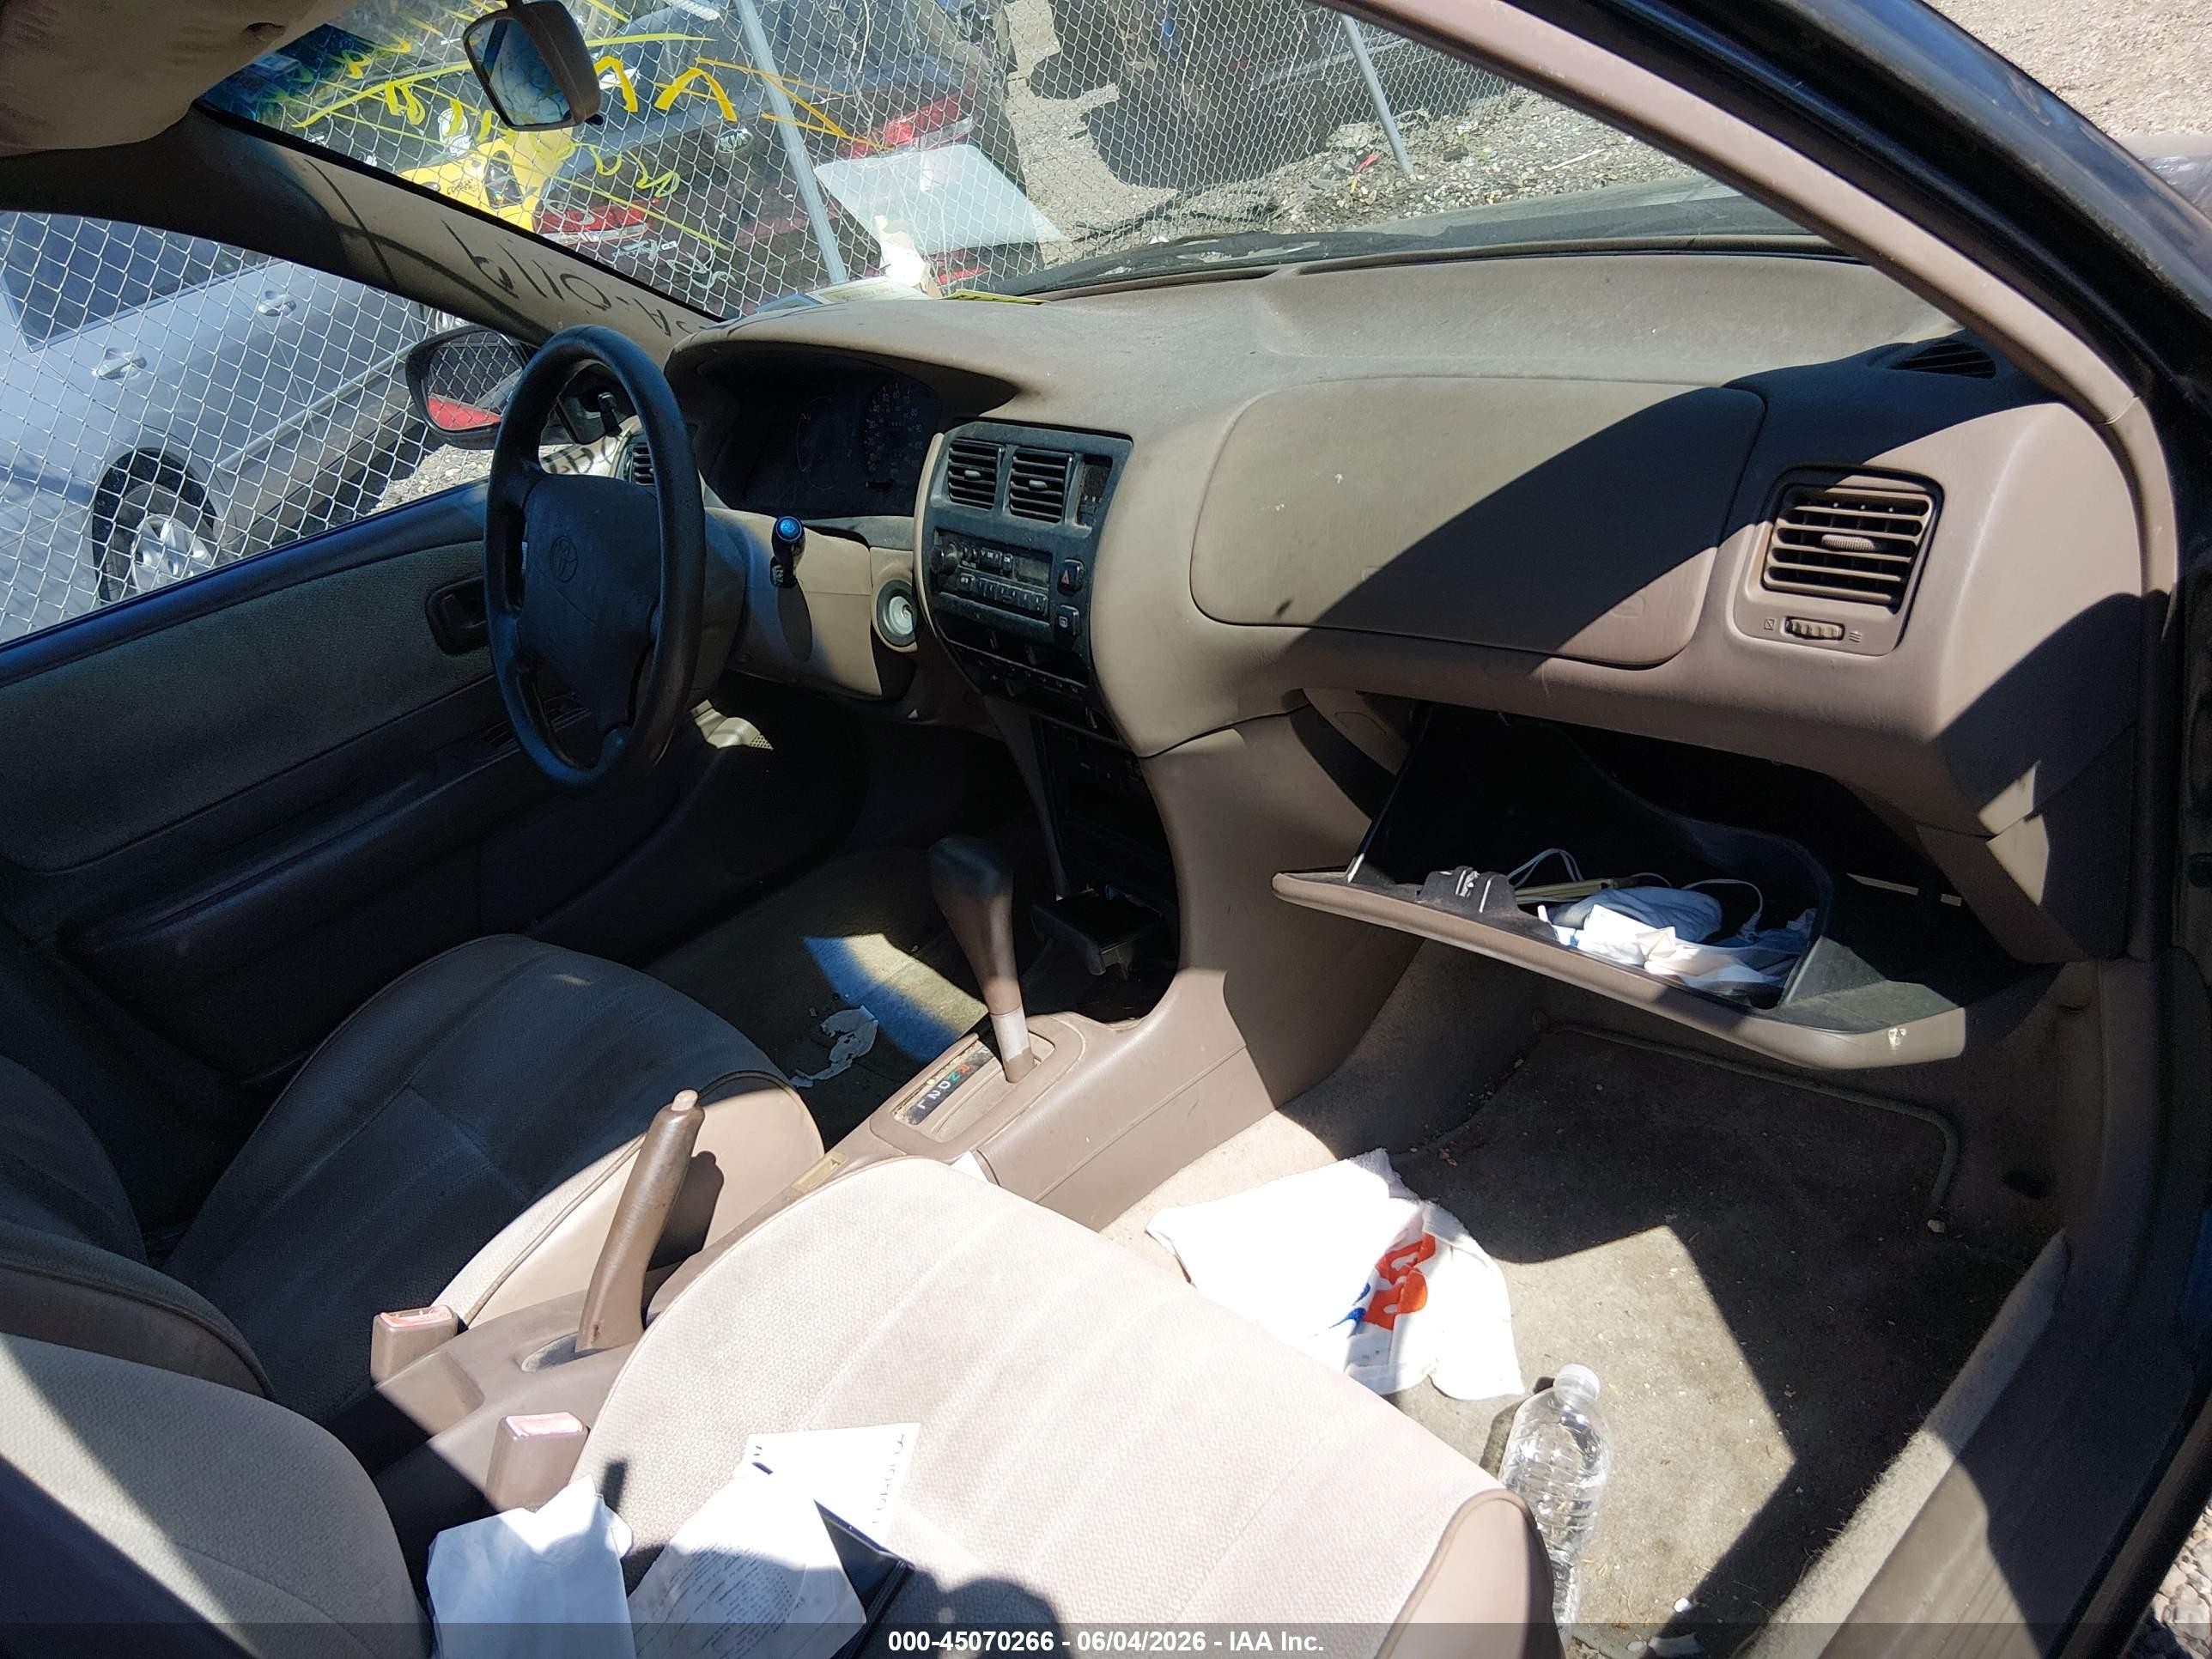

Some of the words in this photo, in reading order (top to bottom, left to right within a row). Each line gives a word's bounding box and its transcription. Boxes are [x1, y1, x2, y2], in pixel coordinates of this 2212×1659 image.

[938, 1080, 951, 1090] D
[927, 1090, 941, 1100] 2
[916, 1099, 927, 1109] L
